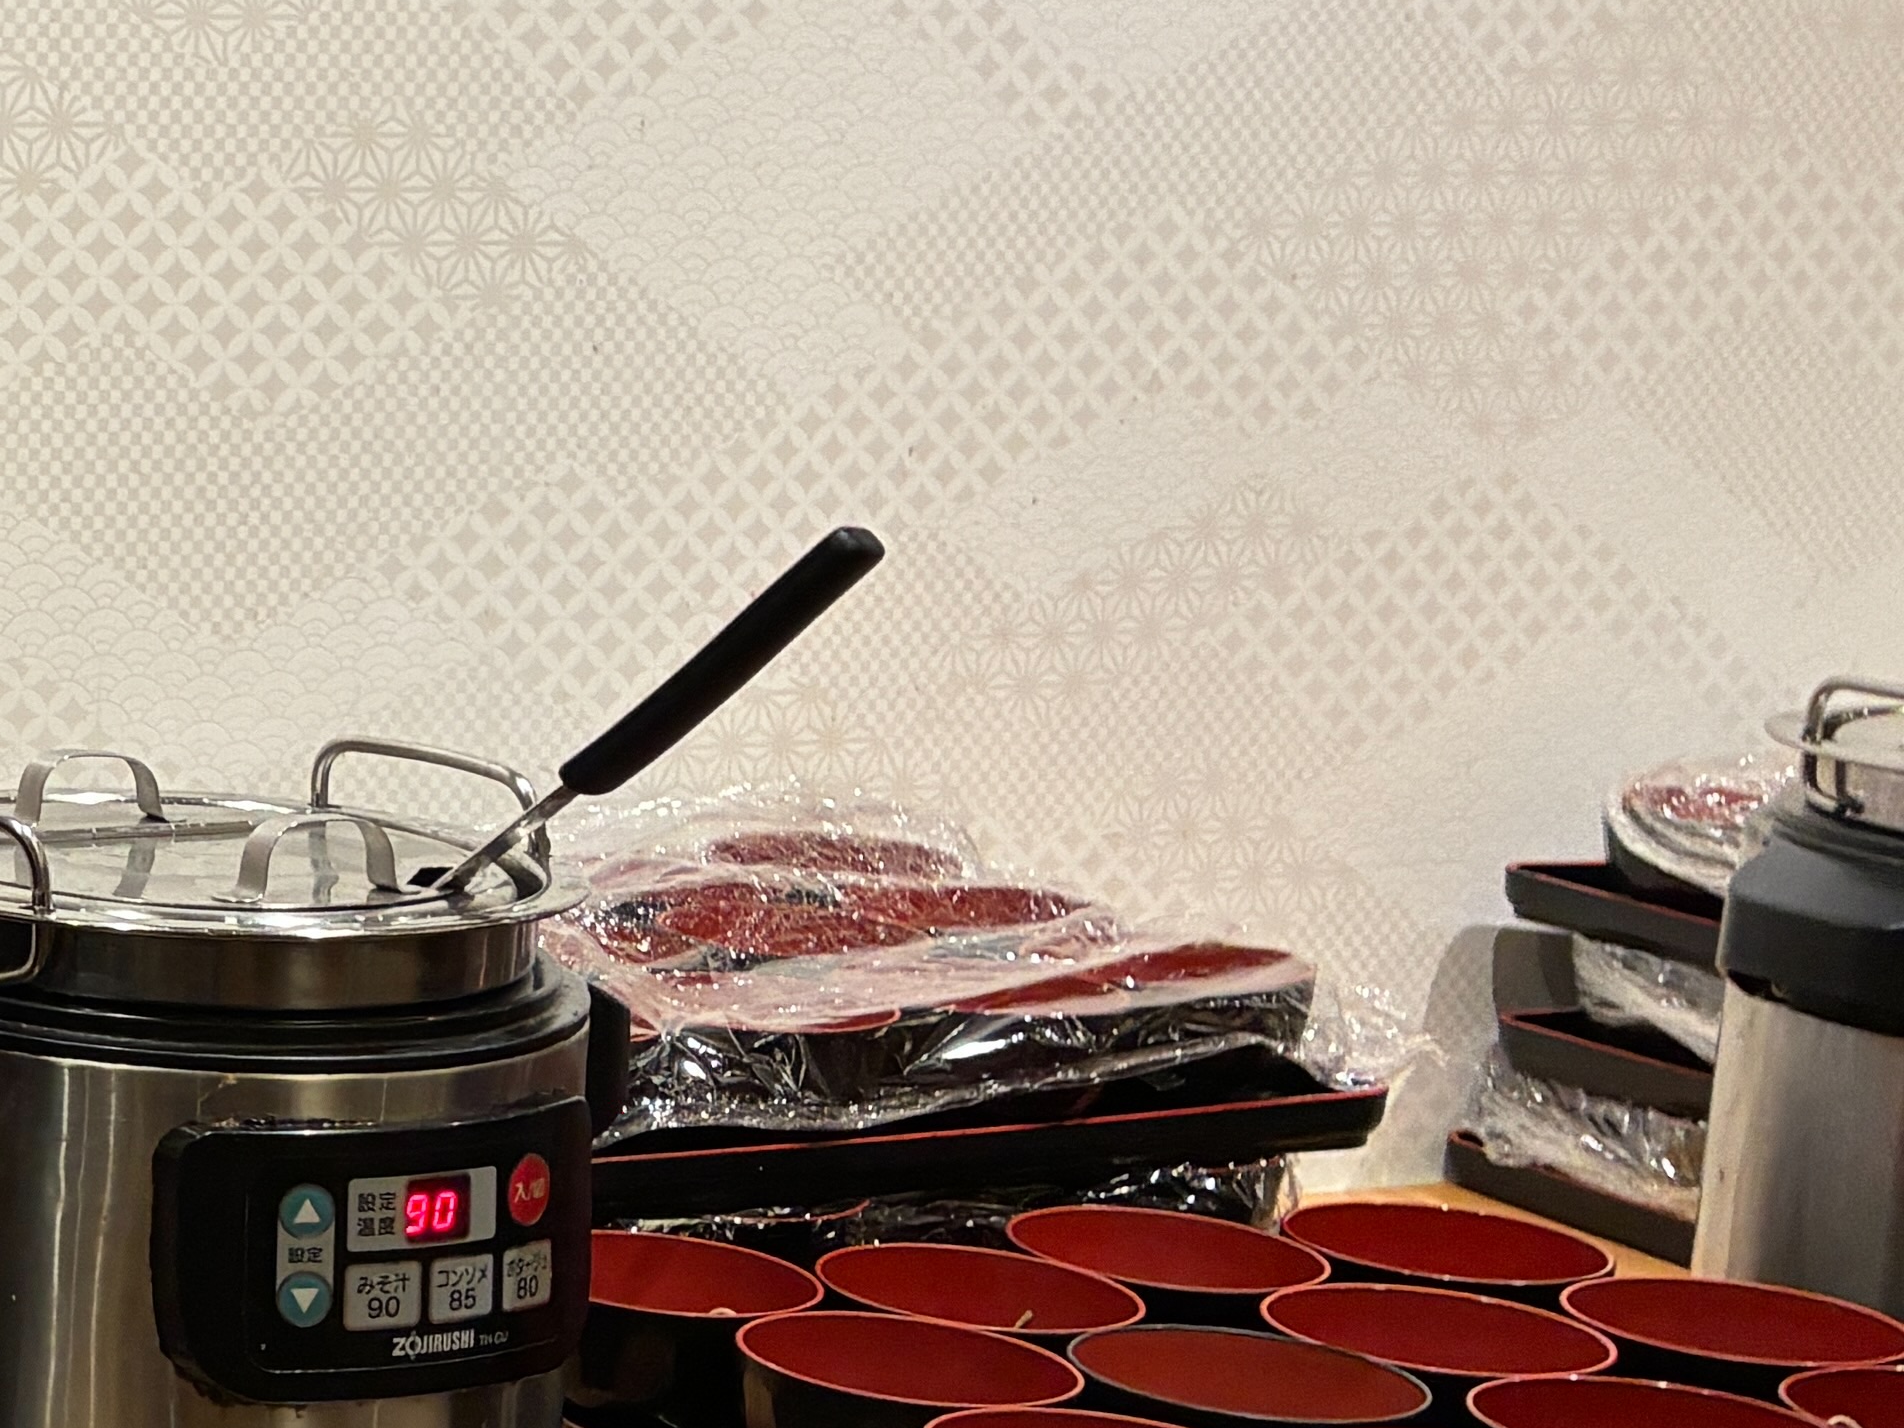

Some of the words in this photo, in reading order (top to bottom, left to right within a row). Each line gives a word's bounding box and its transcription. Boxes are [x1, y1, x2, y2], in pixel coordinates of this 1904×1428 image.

[357, 1190, 397, 1214] 設定
[404, 1189, 459, 1235] 90
[287, 1246, 324, 1265] 設定
[356, 1273, 411, 1297] みそ汁
[435, 1267, 489, 1290] コンソメ
[516, 1274, 539, 1301] 80
[367, 1296, 401, 1320] 90
[448, 1286, 477, 1312] 85
[391, 1327, 475, 1362] ZOJIRUSHI
